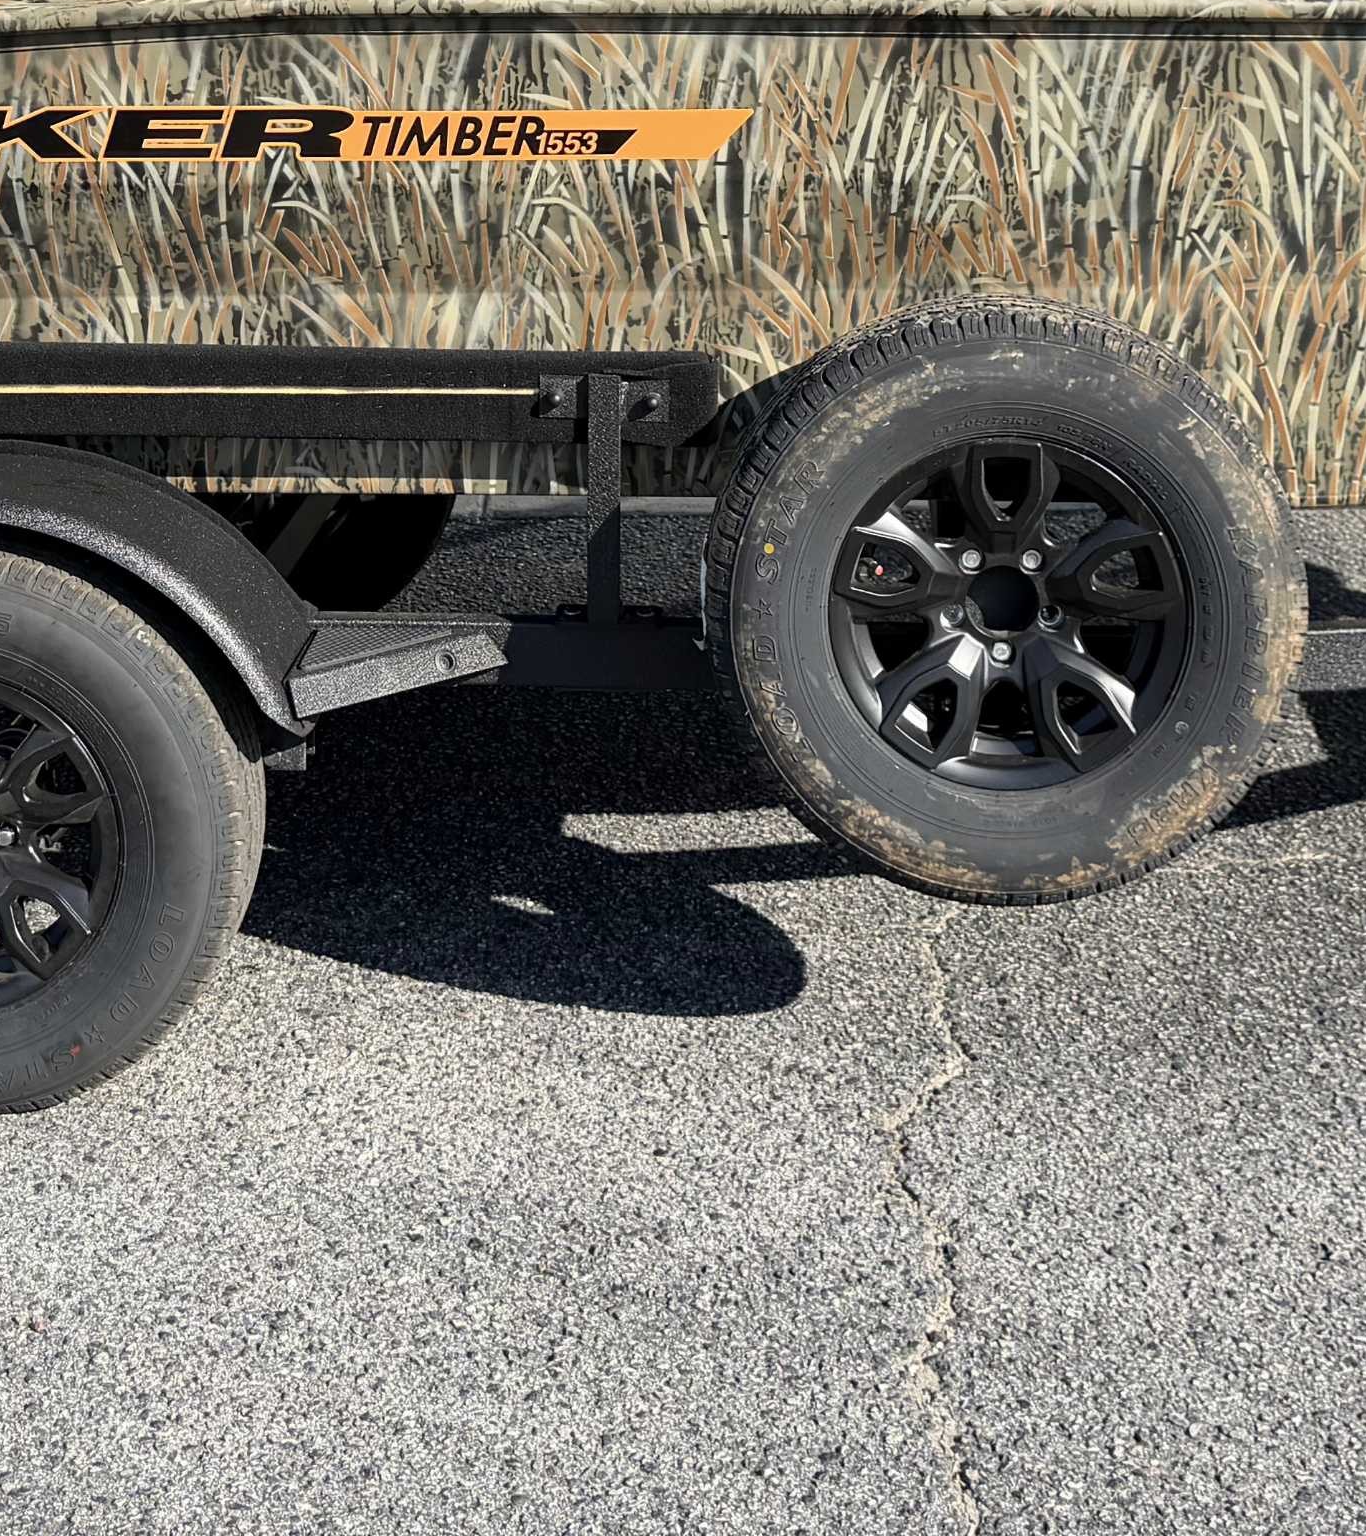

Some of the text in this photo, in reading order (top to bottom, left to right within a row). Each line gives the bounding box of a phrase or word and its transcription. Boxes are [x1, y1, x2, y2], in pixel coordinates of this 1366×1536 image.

[360, 114, 545, 157] TIMBER
[536, 131, 599, 155] 1553
[109, 902, 186, 1024] LOAD
